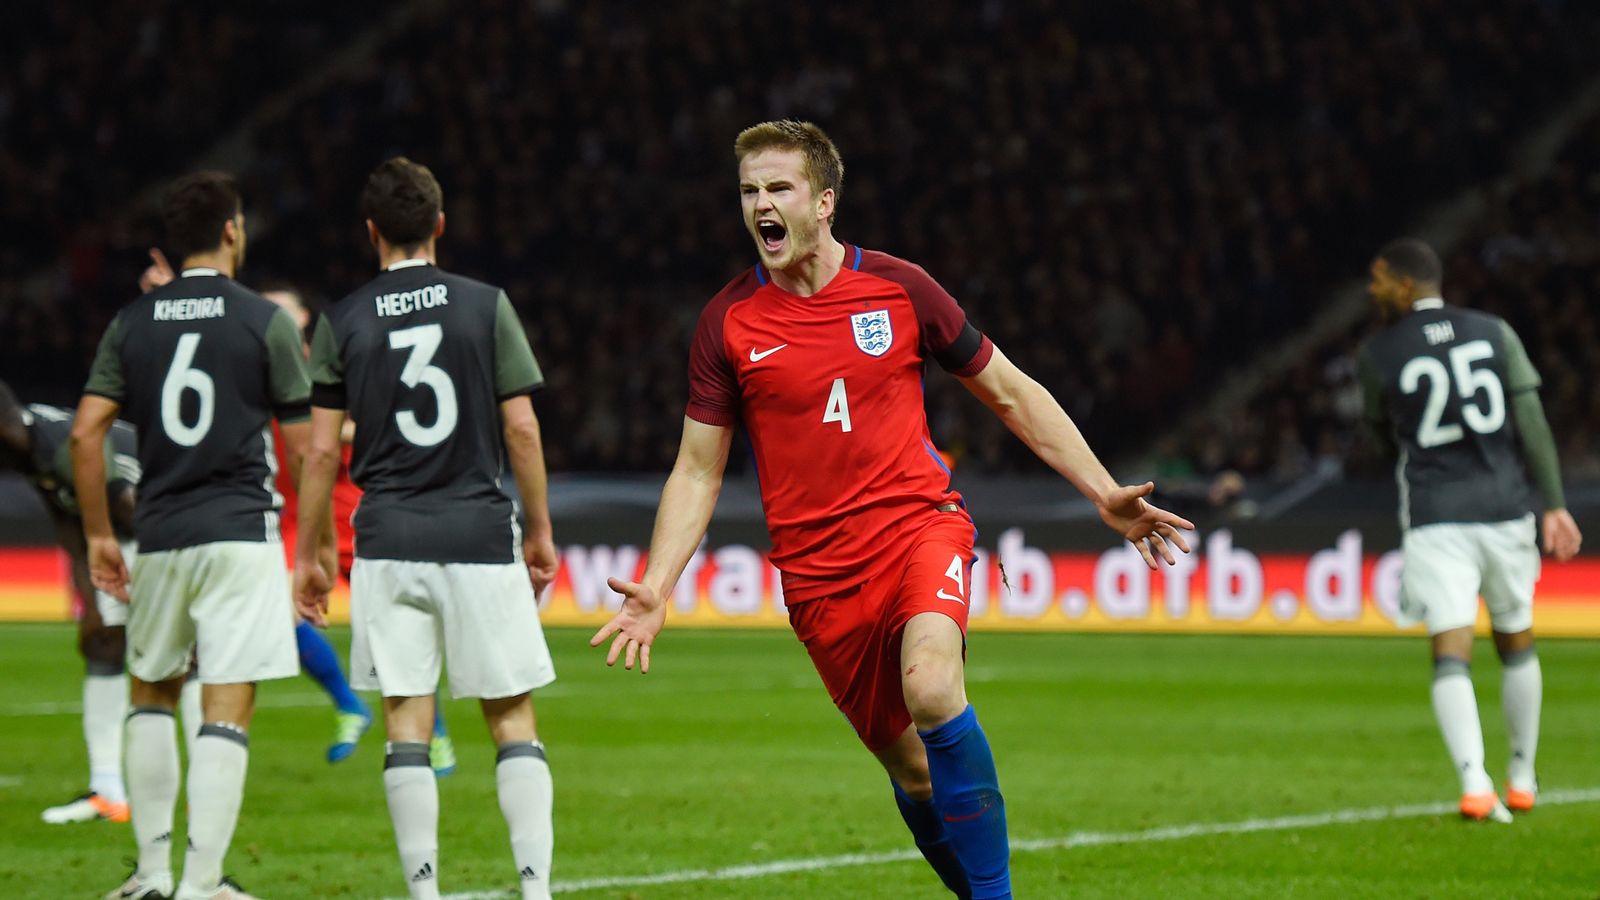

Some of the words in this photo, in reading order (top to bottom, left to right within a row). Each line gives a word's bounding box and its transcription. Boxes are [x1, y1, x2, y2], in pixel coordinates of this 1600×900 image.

[153, 296, 226, 321] KHEDIRA
[375, 283, 449, 317] HECTOR
[1422, 320, 1455, 346] TAH
[161, 332, 216, 447] 6
[388, 323, 458, 447] 3
[822, 377, 852, 433] 4
[1399, 339, 1506, 449] 25
[944, 554, 964, 598] 4
